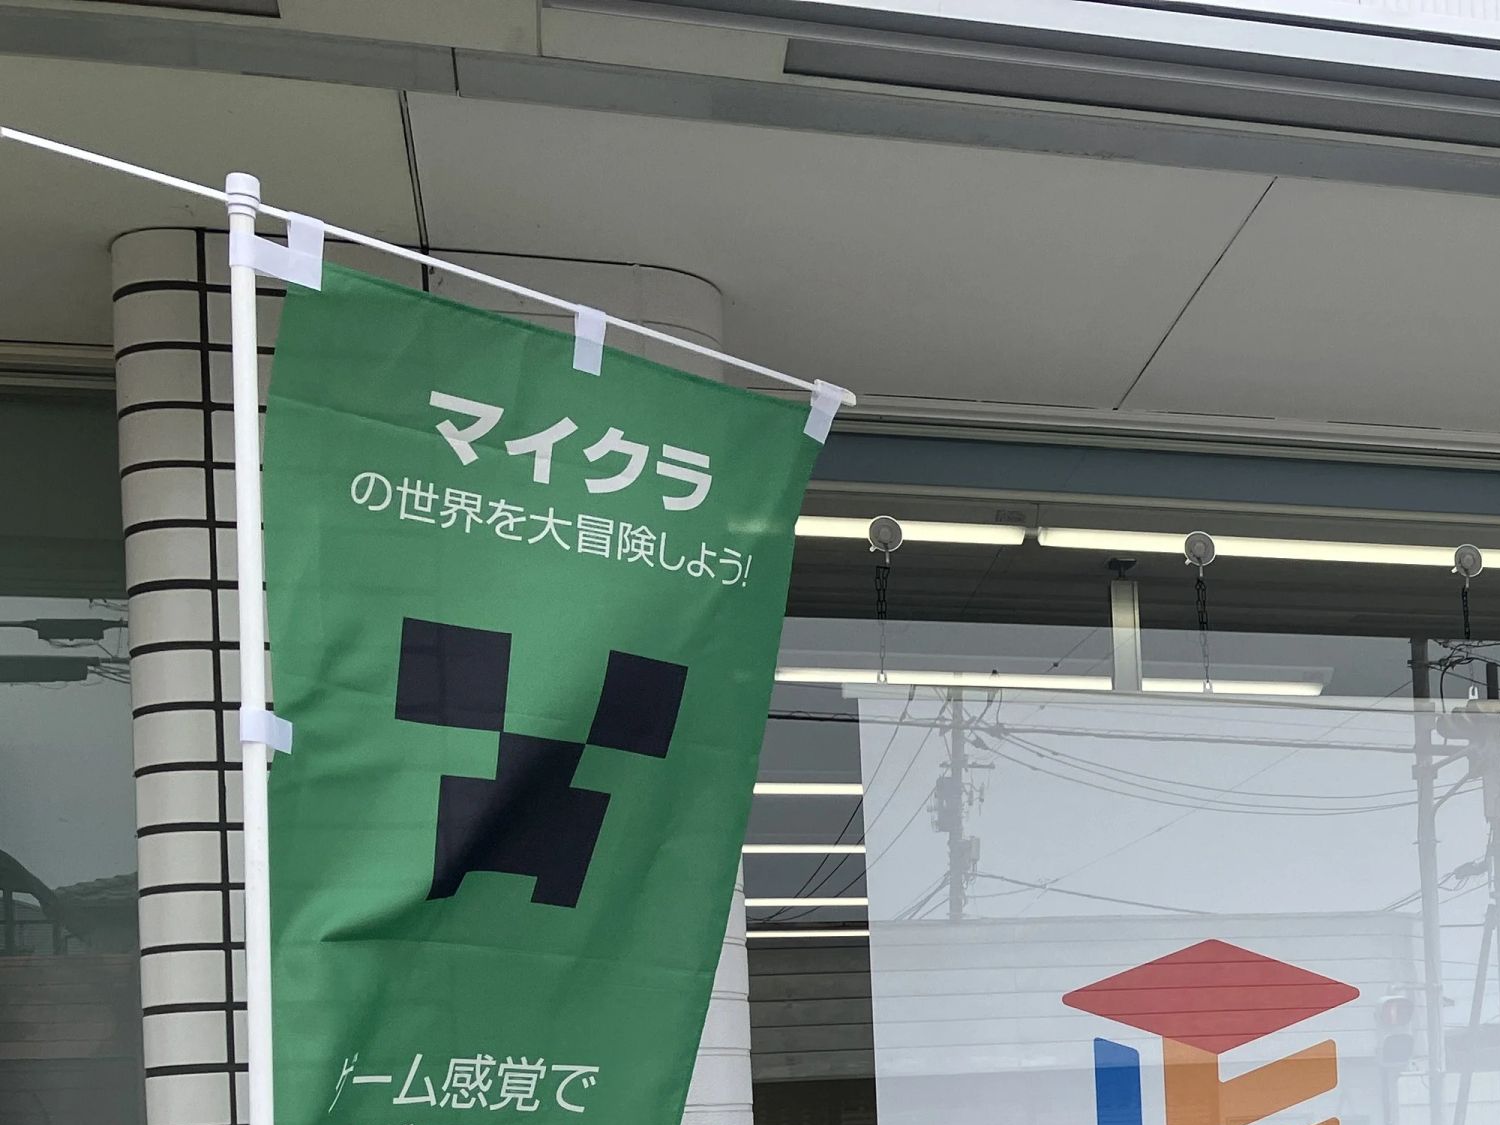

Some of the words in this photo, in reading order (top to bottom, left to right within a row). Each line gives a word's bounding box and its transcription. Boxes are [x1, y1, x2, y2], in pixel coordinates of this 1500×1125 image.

[429, 391, 714, 511] マイクラ
[350, 472, 752, 588] の世界を大冒険しよう!
